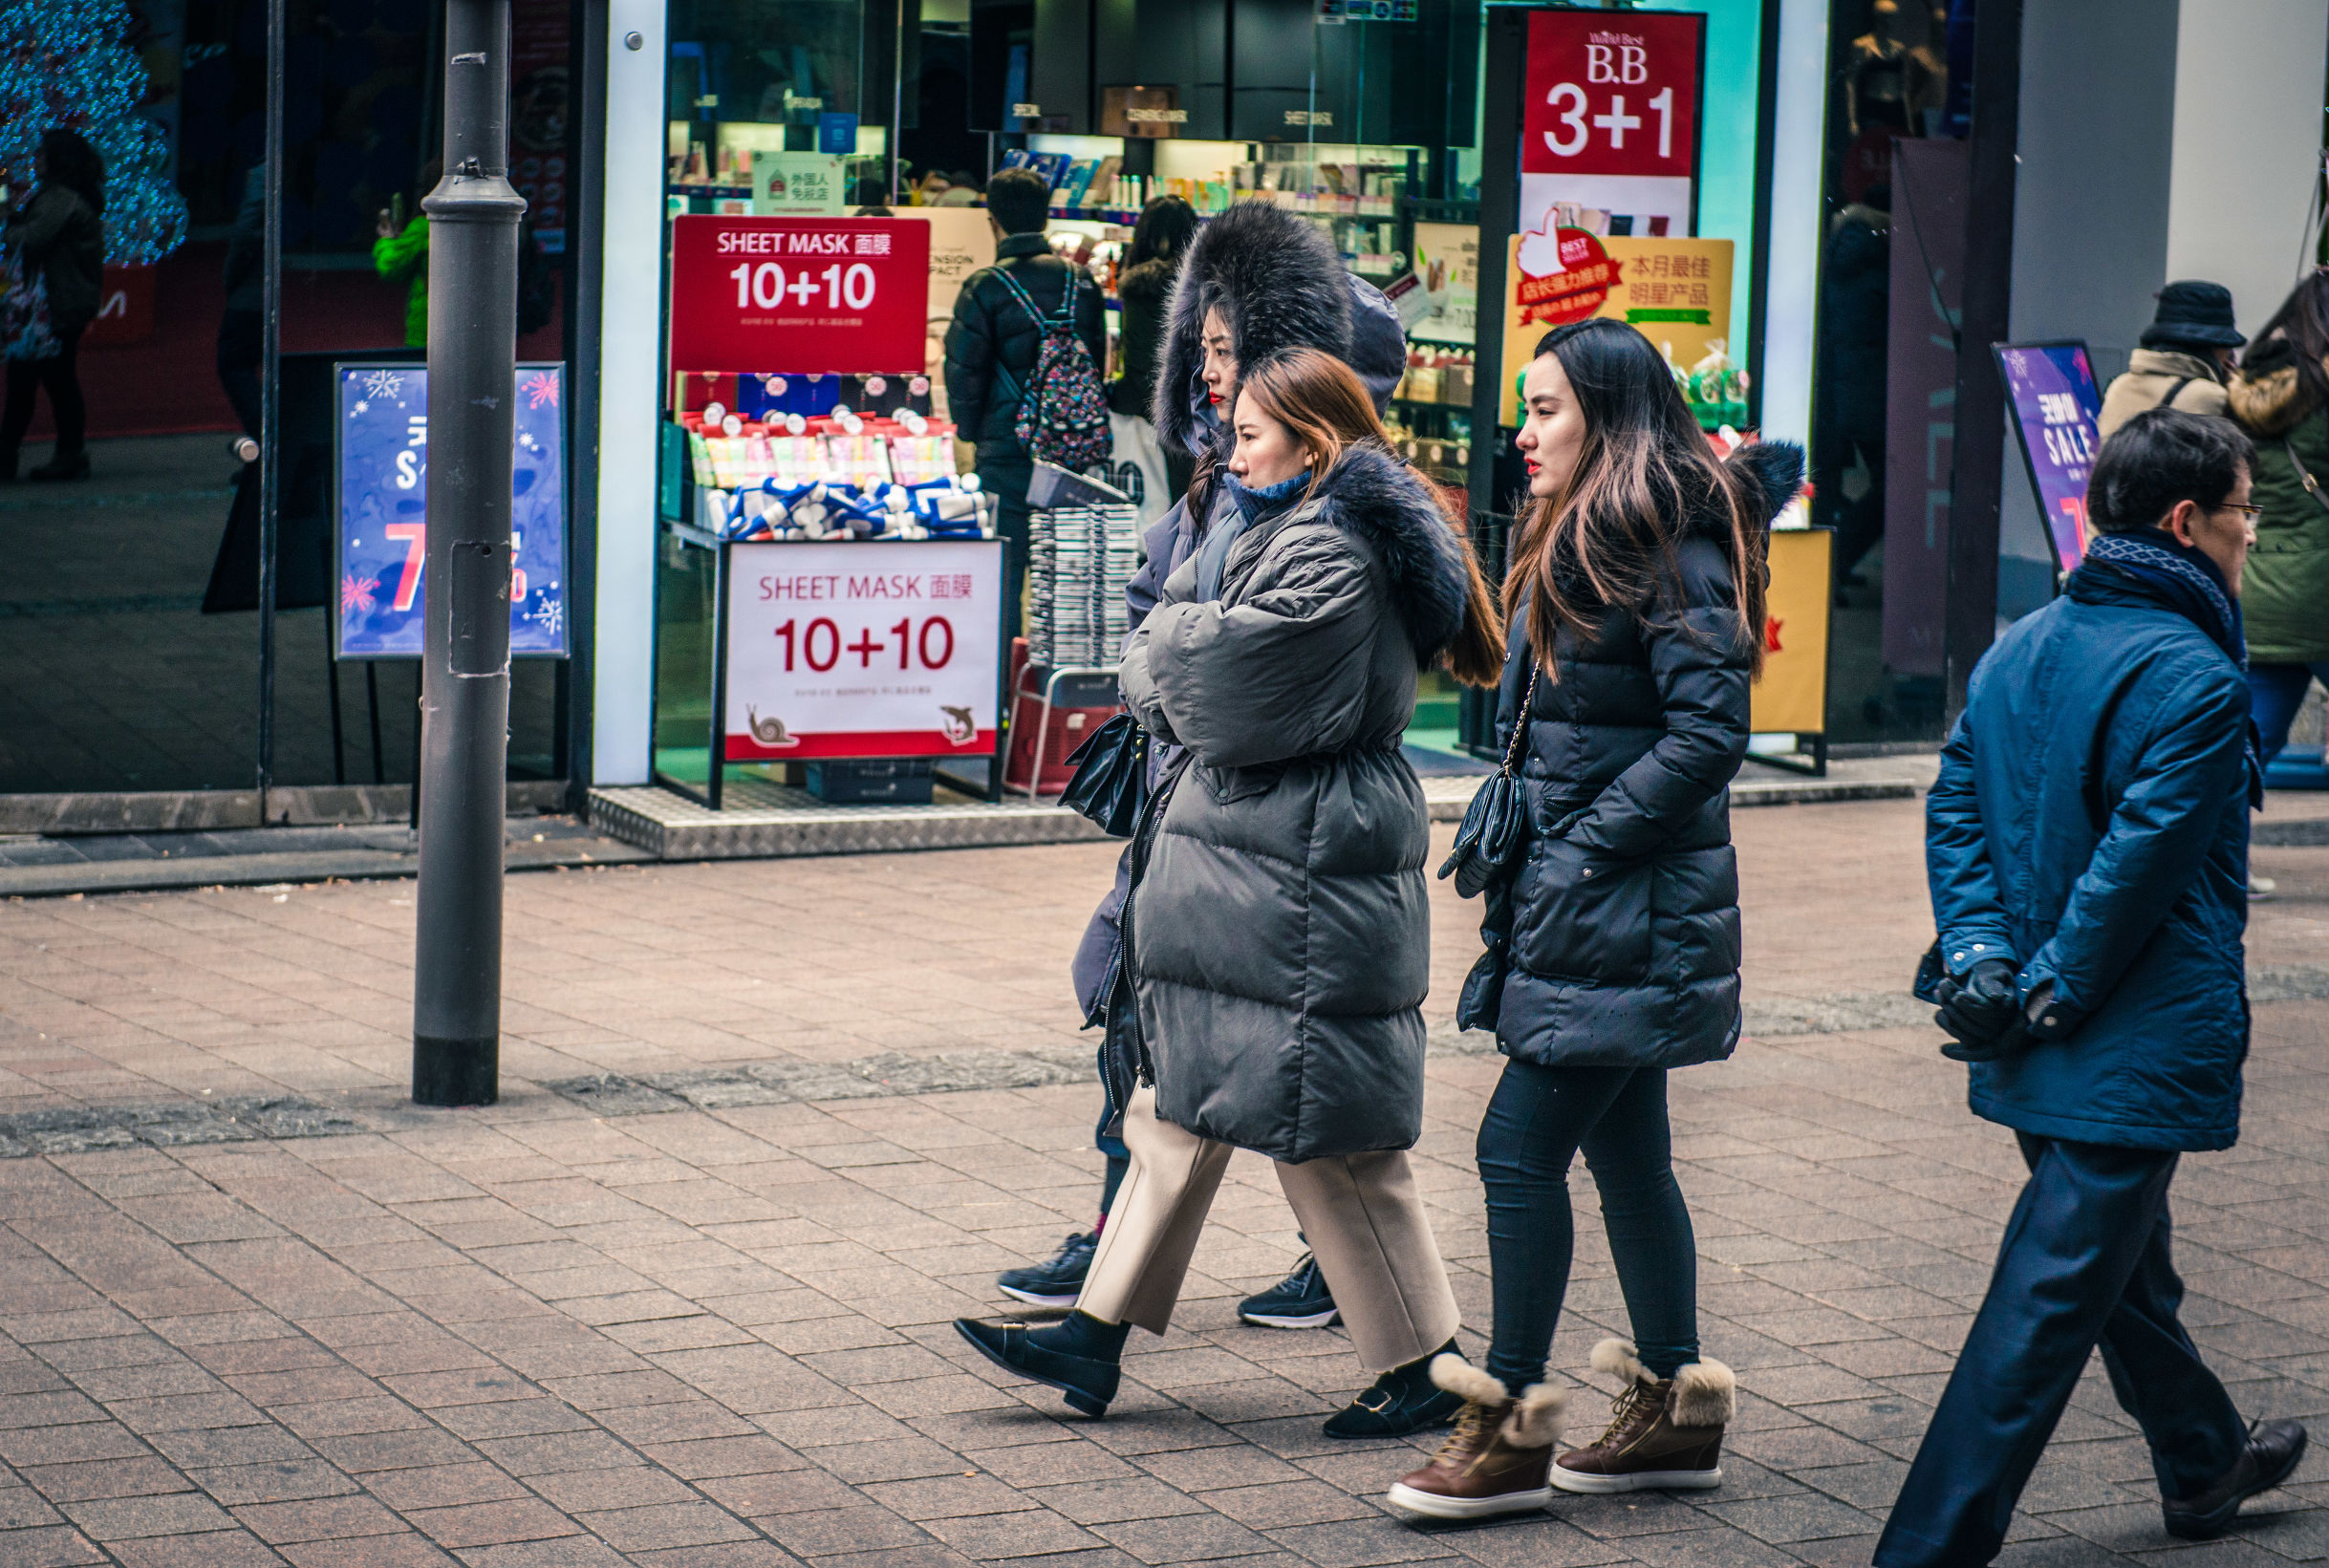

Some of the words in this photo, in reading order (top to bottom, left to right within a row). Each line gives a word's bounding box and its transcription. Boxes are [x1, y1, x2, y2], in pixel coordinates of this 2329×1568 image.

[1543, 82, 1673, 159] 3+1
[718, 232, 786, 254] SHEET
[787, 233, 851, 254] MASK
[854, 233, 892, 255] 面膜
[1629, 254, 1711, 279] 本月最佳
[730, 262, 875, 311] 10+10
[1629, 282, 1709, 307] 明星产品
[2043, 424, 2095, 466] SALE
[759, 575, 841, 601] SHEET
[848, 575, 922, 599] MASK
[930, 573, 973, 599] 面膜
[775, 615, 955, 672] 10+10
